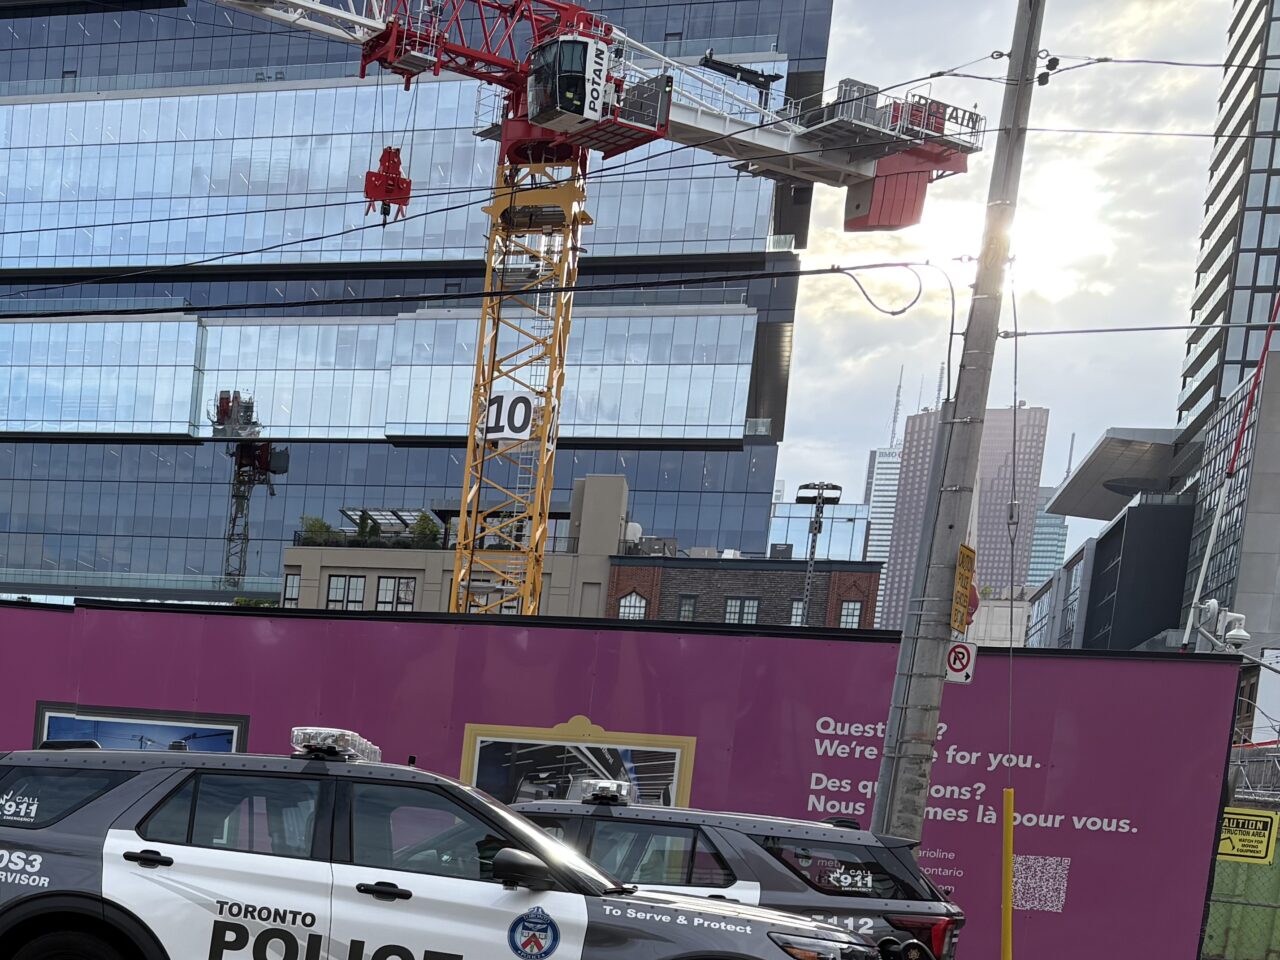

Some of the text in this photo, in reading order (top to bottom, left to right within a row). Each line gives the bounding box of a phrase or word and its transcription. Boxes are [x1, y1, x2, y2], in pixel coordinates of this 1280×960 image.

[589, 48, 605, 113] POTAIN
[486, 395, 532, 434] 10
[816, 717, 948, 741] Quest?
[815, 739, 878, 759] We're
[946, 745, 982, 765] for
[987, 752, 1041, 771] you.
[810, 773, 852, 792] Des
[16, 796, 39, 804] CALL
[807, 795, 866, 815] Nous
[976, 805, 997, 824] là
[1072, 816, 1139, 833] vous.
[1223, 818, 1264, 830] AUTION
[216, 900, 317, 928] TORONTO
[603, 906, 752, 934] To Serve & Protect
[812, 915, 874, 935] 112
